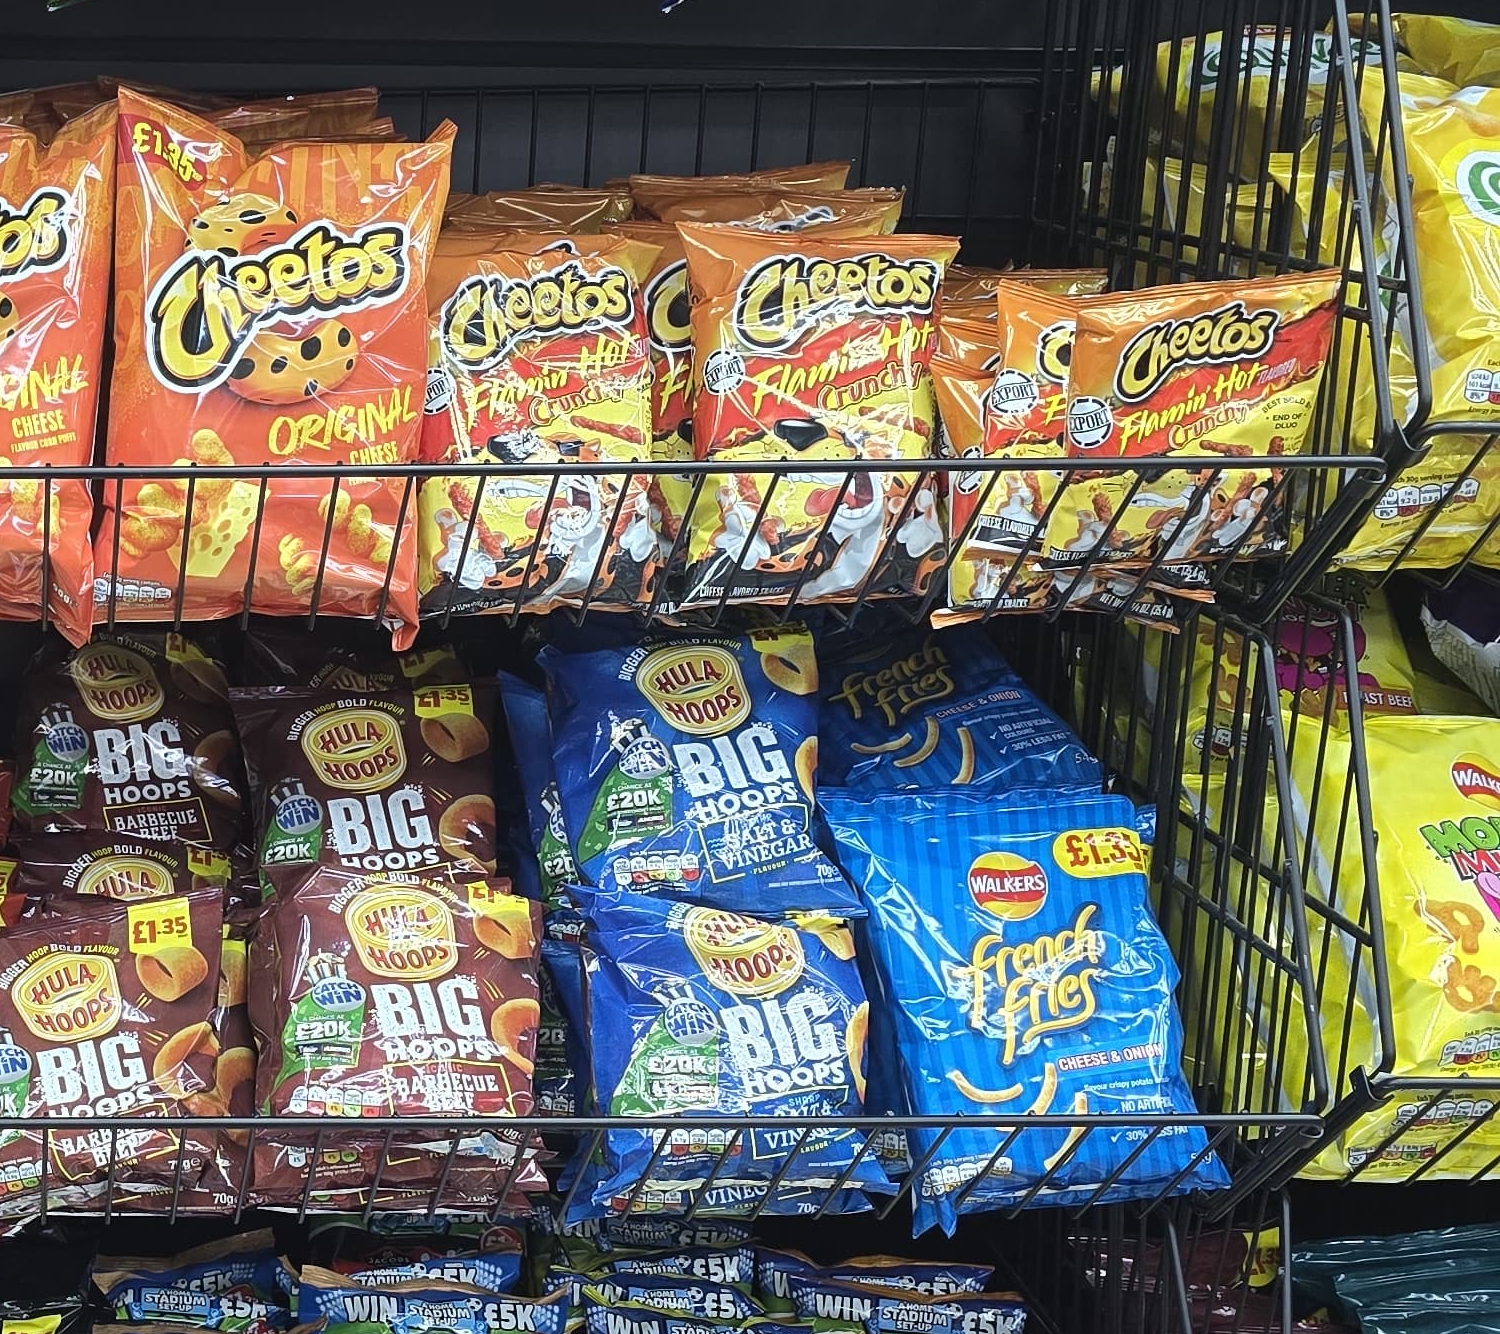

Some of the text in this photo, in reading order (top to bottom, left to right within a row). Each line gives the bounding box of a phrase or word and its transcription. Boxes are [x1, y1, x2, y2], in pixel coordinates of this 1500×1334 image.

[154, 231, 404, 387] Cheetos
[742, 255, 937, 344] Cheetos
[1119, 305, 1271, 395] Cheetos
[817, 361, 922, 412] Crunchy
[992, 383, 1035, 405] EXPORT
[1213, 363, 1260, 397] Hot
[11, 409, 66, 434] CHEESE
[268, 387, 418, 457] ORIGINAL
[1169, 403, 1250, 447] Crunchy
[418, 689, 470, 709] £1.35
[115, 806, 198, 833] BARBECUE
[327, 789, 434, 855] BIG
[970, 872, 1047, 896] WALKERS
[132, 916, 189, 944] £1.35
[33, 998, 115, 1034] HOOPS
[1058, 1053, 1109, 1071] CHEESE
[1110, 1052, 1121, 1063] &
[1109, 1077, 1153, 1089] crispy potato
